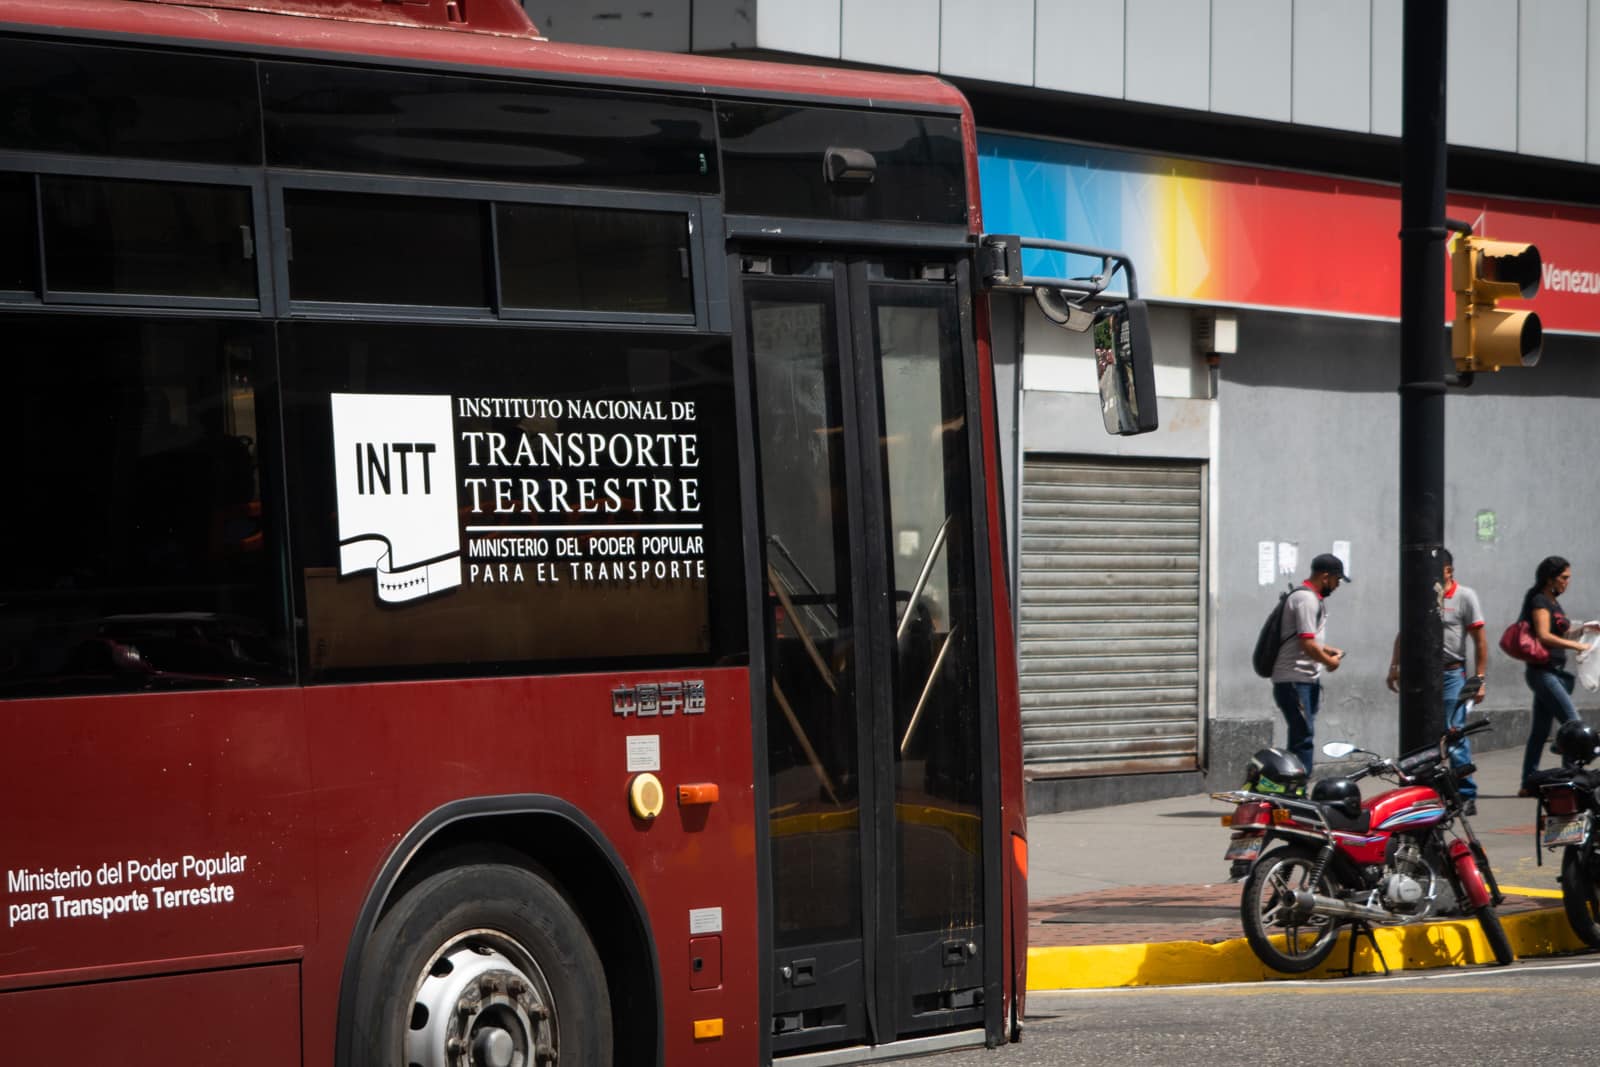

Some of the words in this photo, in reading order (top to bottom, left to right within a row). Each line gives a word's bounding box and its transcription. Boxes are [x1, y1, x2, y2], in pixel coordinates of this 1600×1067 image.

[1541, 263, 1600, 294] Venezu
[459, 397, 562, 418] INSTITUTO
[567, 400, 667, 420] NACIONAL
[671, 401, 696, 421] DE
[462, 432, 699, 467] TRANSPORTE
[356, 443, 436, 495] INTT
[465, 478, 701, 513] TERRESTRE
[469, 538, 549, 557] MINISTERIO
[556, 537, 582, 556] DEL
[590, 537, 635, 555] PODER
[643, 536, 704, 555] POPULAR
[470, 564, 524, 583] PARA
[538, 563, 559, 582] EL
[571, 560, 705, 581] TRANSPORTE
[8, 865, 92, 892] Ministerio
[97, 862, 123, 885] del
[128, 858, 179, 882] Poder
[182, 852, 247, 879] Popular
[9, 903, 49, 927] para
[52, 890, 150, 919] Transporte
[152, 882, 234, 909] Terrestre
